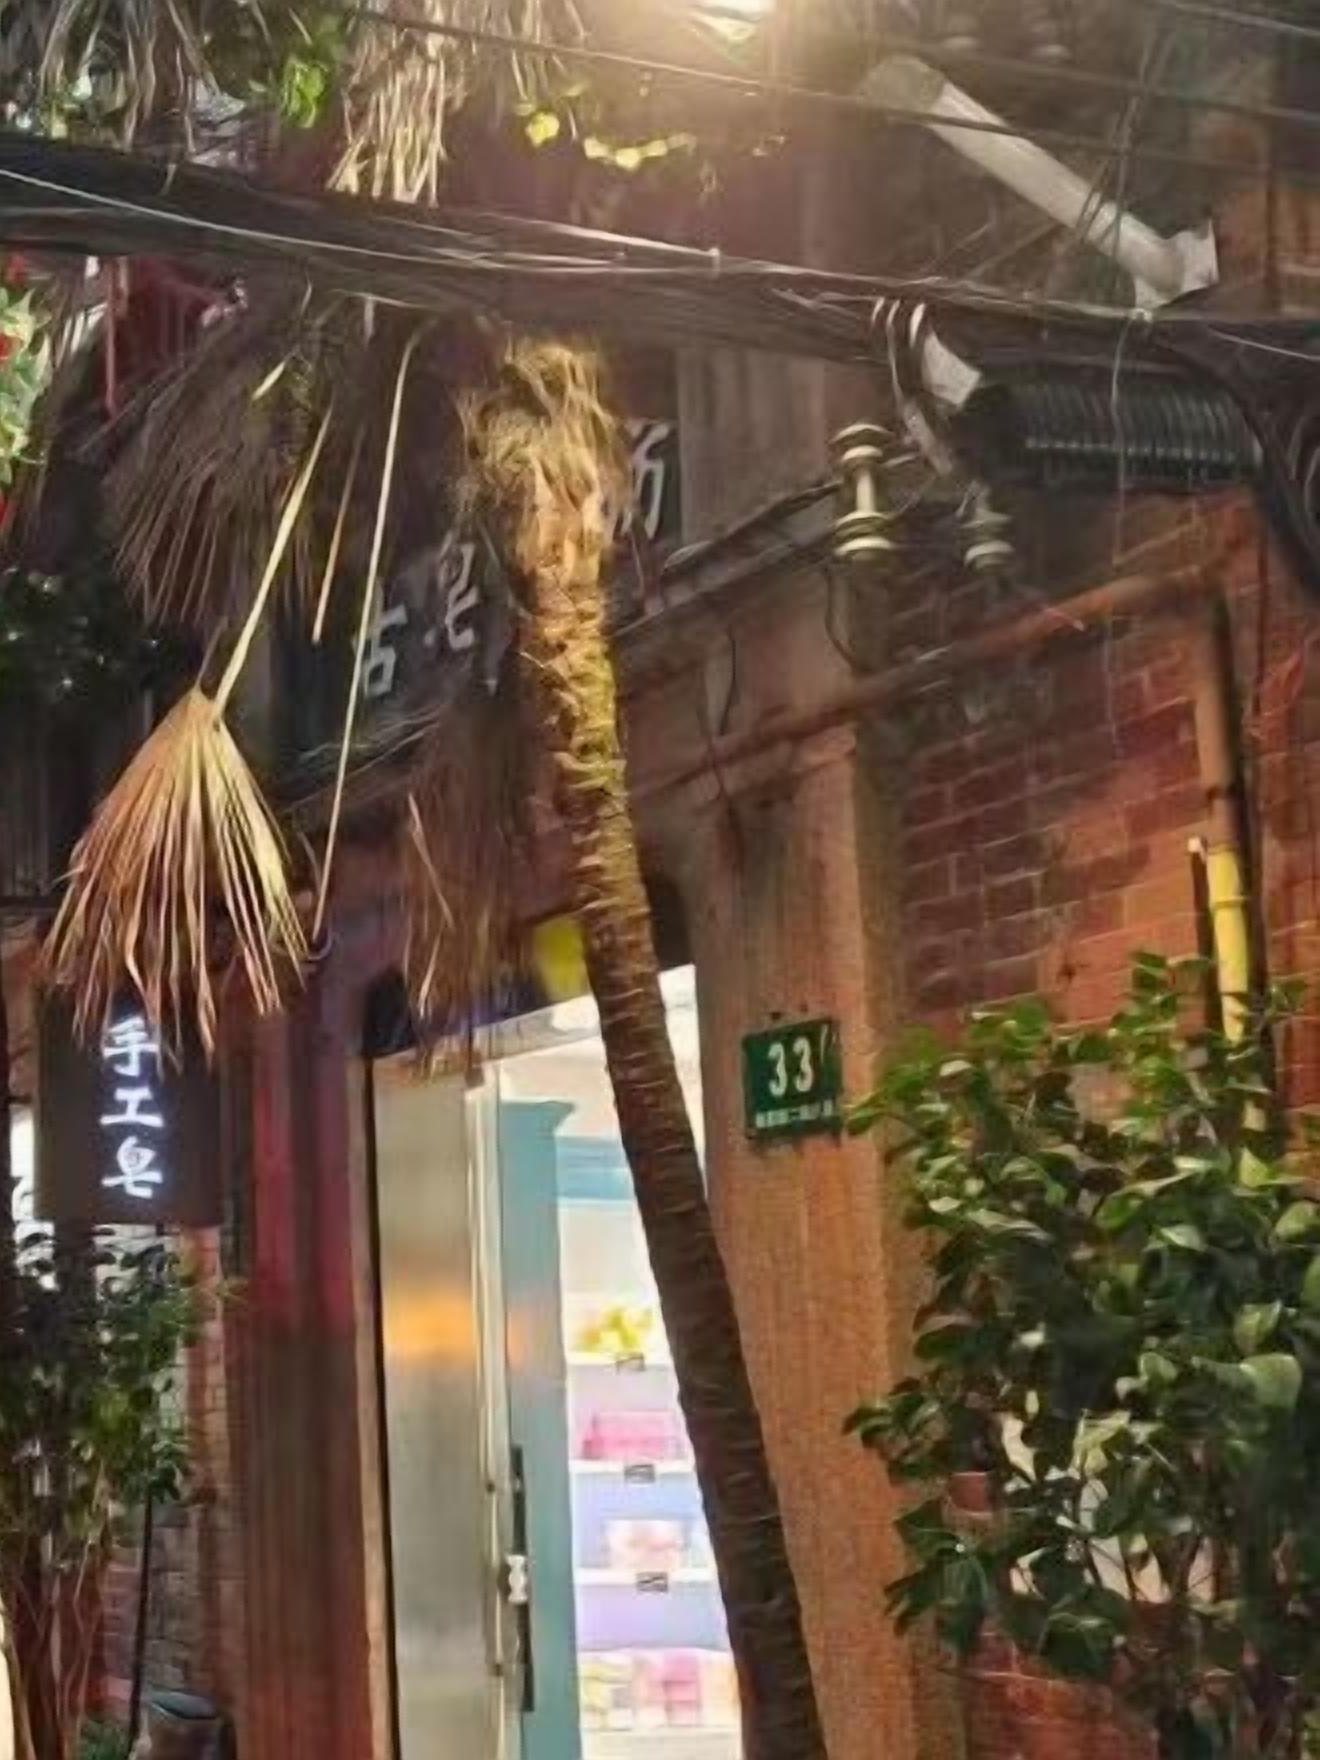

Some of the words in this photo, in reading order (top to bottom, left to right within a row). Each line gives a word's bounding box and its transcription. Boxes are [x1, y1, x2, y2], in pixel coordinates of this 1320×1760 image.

[100, 1016, 164, 1199] 手工皂
[767, 1037, 814, 1097] 33
